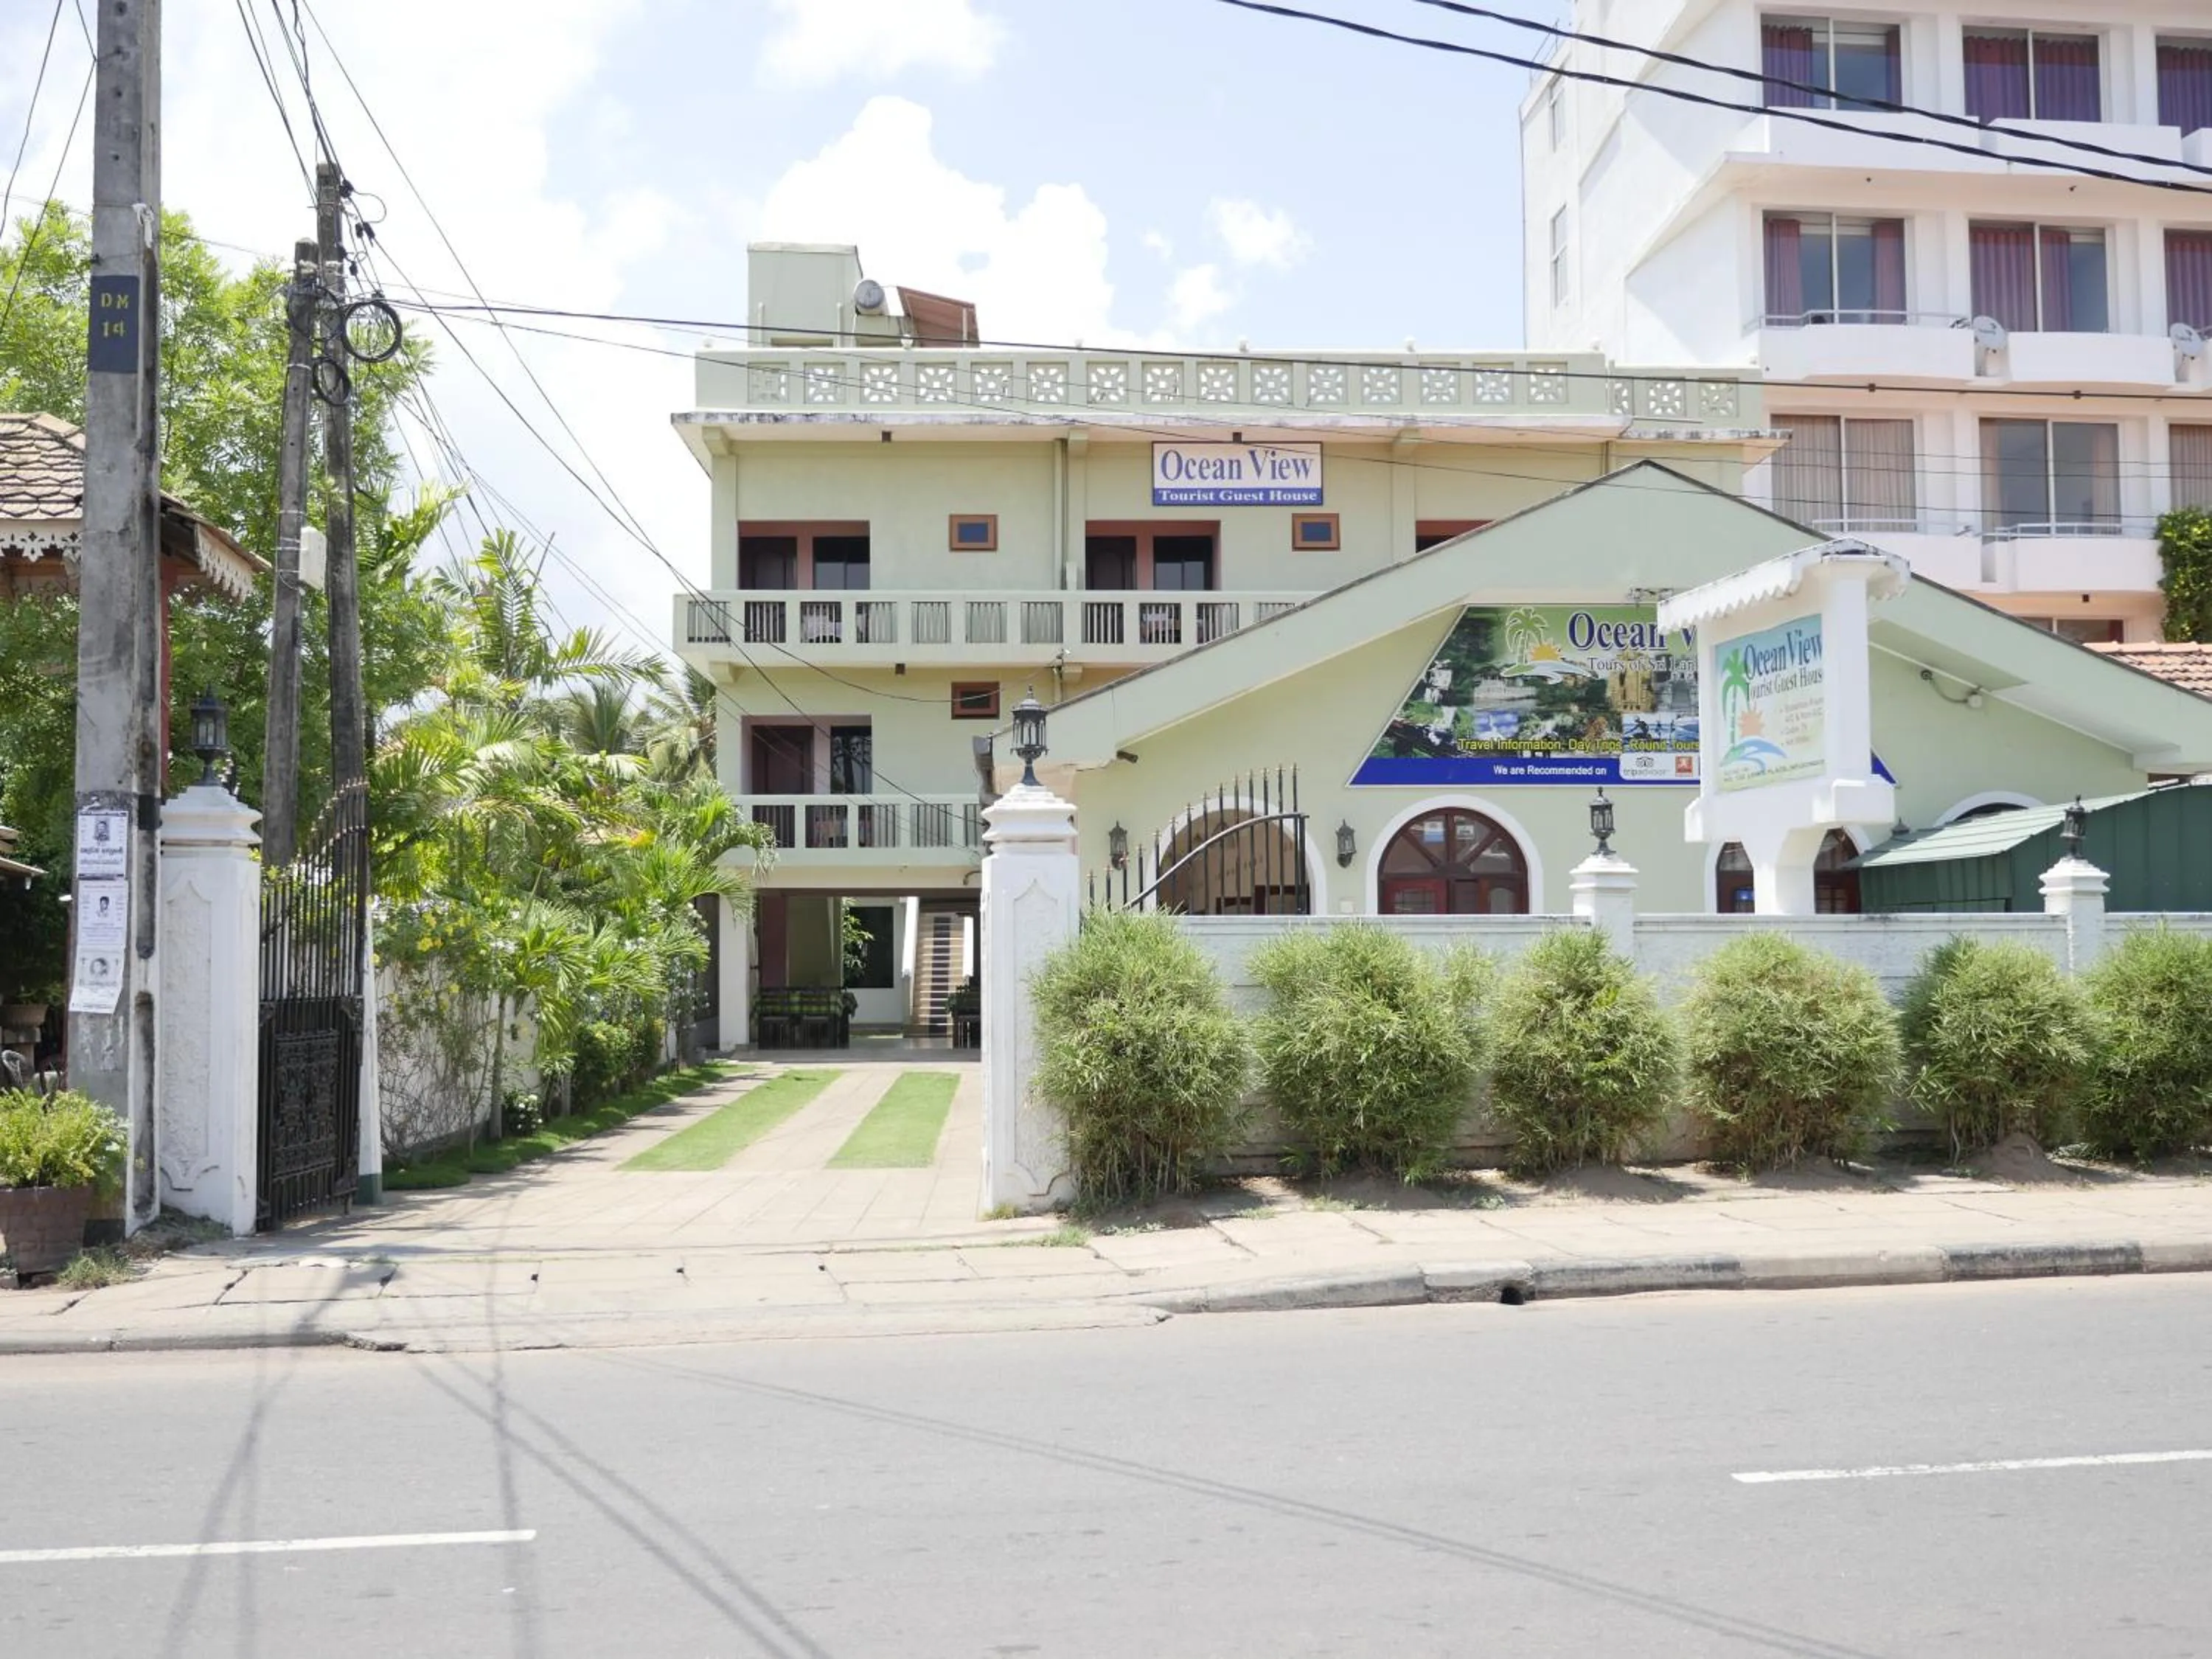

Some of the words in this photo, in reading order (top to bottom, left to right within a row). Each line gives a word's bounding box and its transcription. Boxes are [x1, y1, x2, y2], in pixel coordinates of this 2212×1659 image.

[102, 319, 124, 338] 14
[1161, 448, 1242, 481] Ocean
[1248, 449, 1314, 481] View
[1158, 490, 1215, 501] Tourist
[1219, 490, 1265, 501] Guest
[1269, 490, 1318, 501] House
[1744, 643, 1786, 680] Ocean
[1787, 629, 1822, 666] View
[1587, 656, 1624, 671] Tours
[1745, 678, 1773, 701] Tourist
[1775, 672, 1798, 693] Guest
[1458, 738, 1493, 751] Travel
[1568, 738, 1592, 753] Day
[1493, 765, 1508, 775] We
[1509, 767, 1525, 775] are
[1526, 765, 1593, 775] Recommended
[1595, 767, 1607, 775] on
